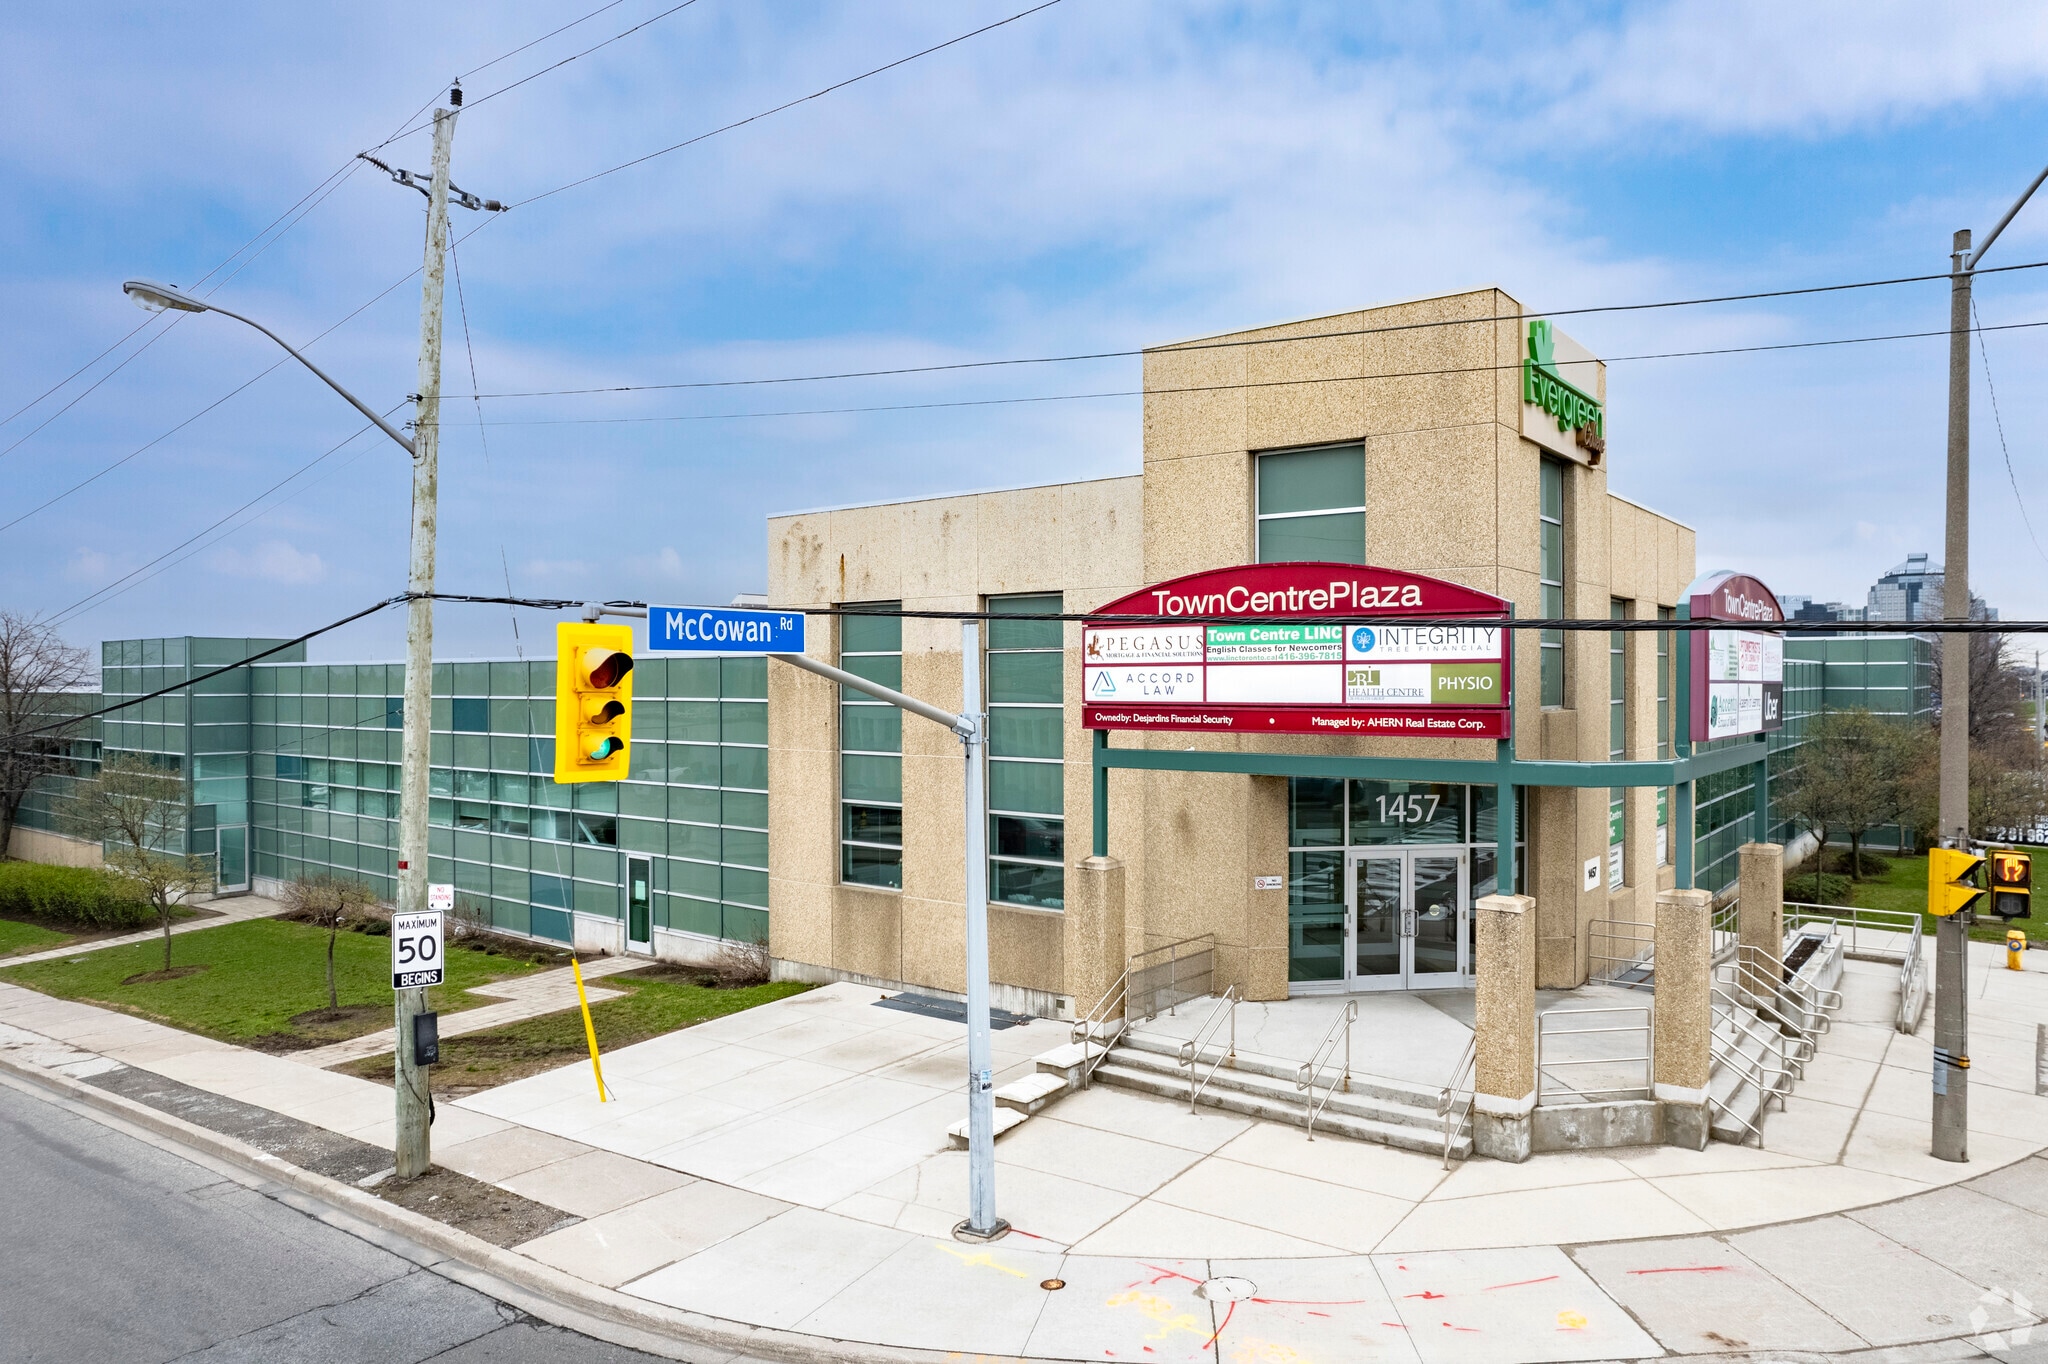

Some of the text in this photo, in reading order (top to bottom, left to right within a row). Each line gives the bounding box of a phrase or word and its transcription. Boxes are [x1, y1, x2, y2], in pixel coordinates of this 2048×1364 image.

[1524, 357, 1603, 438] Evergreen
[1152, 581, 1422, 616] TownCentrePlaza
[665, 611, 793, 642] McCowan Rd
[1207, 626, 1342, 642] Town Centre LINC
[1106, 635, 1203, 651] PEGASUS
[1379, 627, 1495, 645] INTEGRITY
[1206, 646, 1236, 654] English
[1239, 645, 1272, 653] Classes
[1289, 643, 1342, 652] Newcomers
[1126, 673, 1194, 684] ACCORD
[1438, 676, 1493, 690] PHYSIO
[1143, 685, 1175, 695] LAW
[1348, 688, 1424, 696] HEALTH CENTRE
[1764, 691, 1779, 721] Uber
[1133, 713, 1169, 724] Desjardins
[1171, 714, 1201, 723] Financial
[1202, 715, 1233, 726] Security
[1312, 717, 1486, 731] Managed by: AHERN Real Estate Corp.
[1375, 794, 1441, 823] 1457
[398, 918, 437, 930] MAXIMUM
[398, 935, 437, 964] 50
[401, 970, 438, 987] BEGINS
